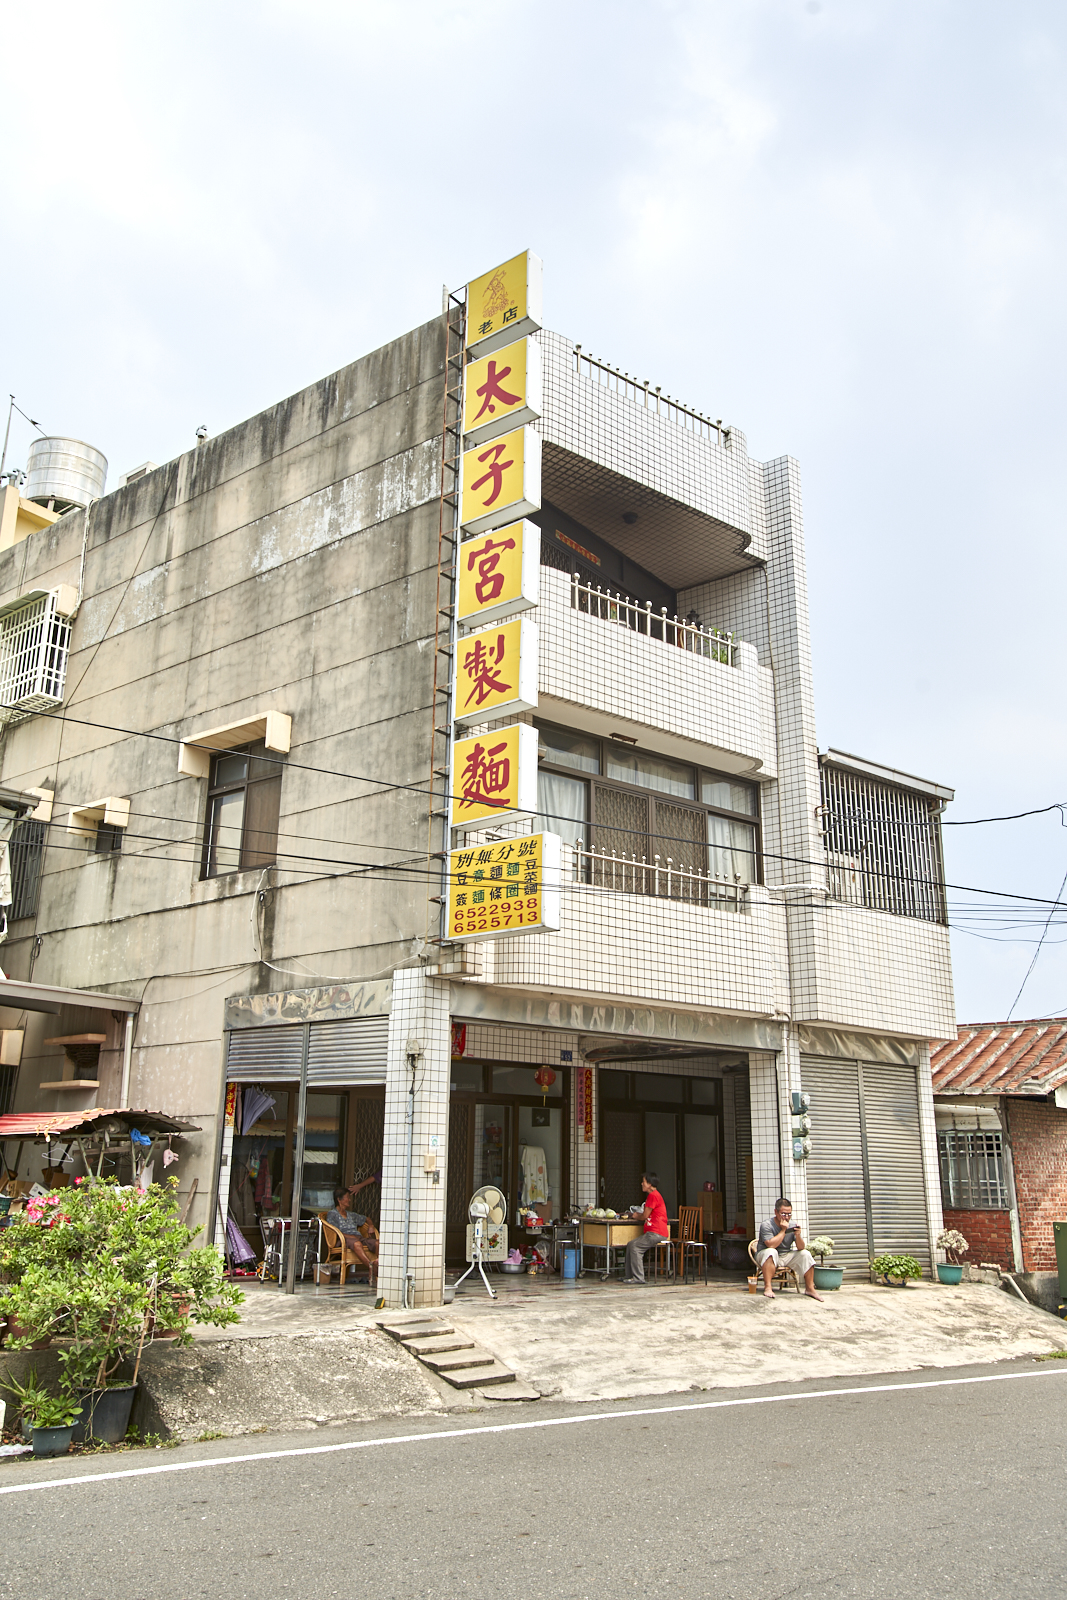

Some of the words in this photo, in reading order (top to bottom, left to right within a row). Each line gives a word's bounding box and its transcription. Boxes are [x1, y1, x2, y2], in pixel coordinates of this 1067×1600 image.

[478, 305, 519, 335] 老店
[459, 361, 522, 809] 太子宮製麵
[454, 840, 538, 870] 別無分號
[454, 898, 538, 920] 6522938
[454, 911, 538, 933] 6525713
